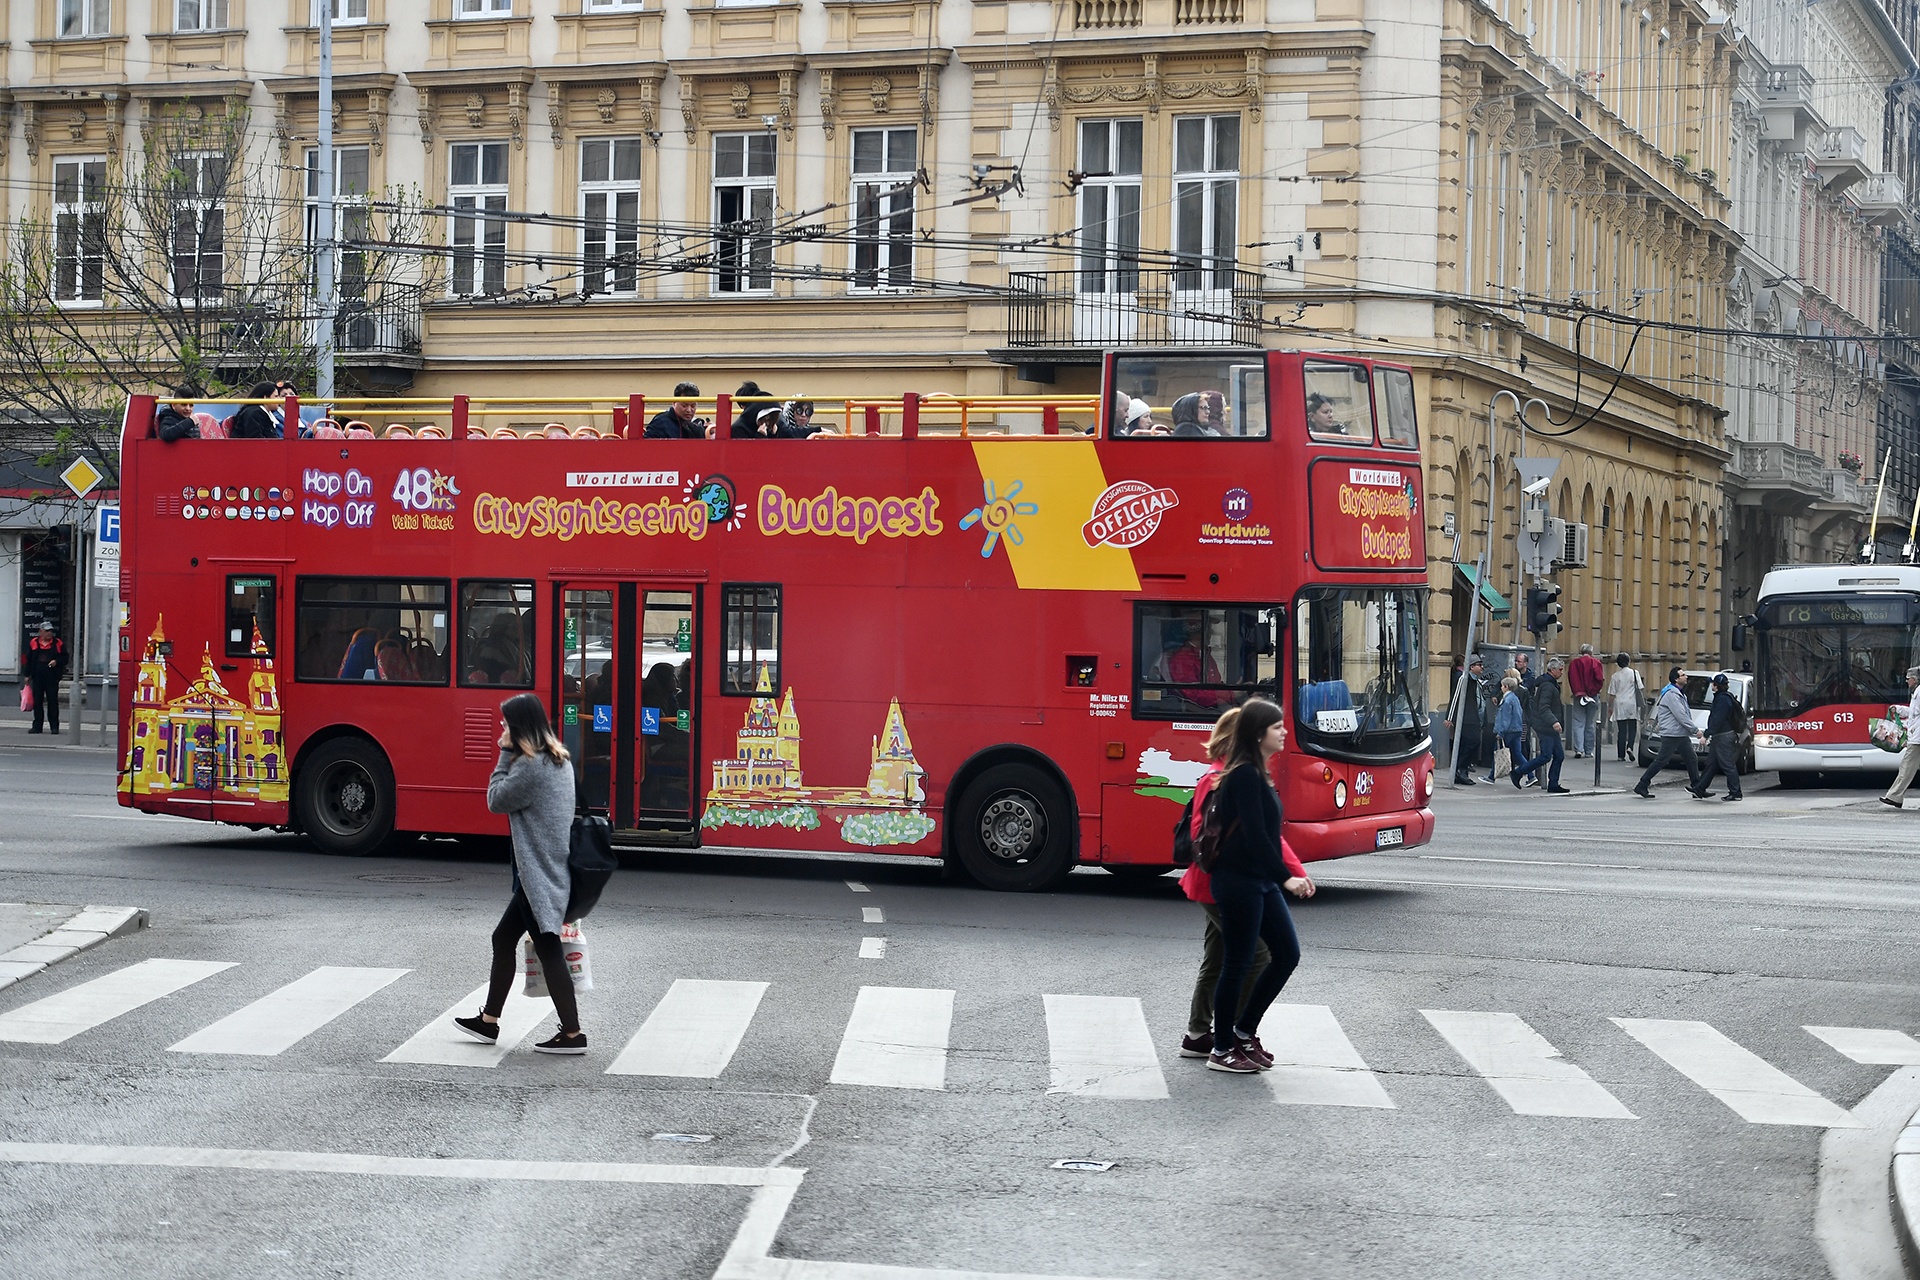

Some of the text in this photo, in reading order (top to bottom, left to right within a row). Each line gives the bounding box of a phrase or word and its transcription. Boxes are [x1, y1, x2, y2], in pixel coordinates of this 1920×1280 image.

[303, 469, 373, 498] Hop On
[575, 473, 675, 485] Worldwide
[1354, 470, 1400, 485] Worldwide
[392, 468, 433, 510] 48
[1098, 484, 1147, 512] CITYSIGHTSEEING
[303, 500, 376, 528] Hop Off
[392, 514, 455, 531] Valid Ticket
[474, 484, 944, 545] CitySightseeing Budapest
[1091, 492, 1174, 540] OFFICIAL
[1120, 518, 1157, 543] TOUR
[1201, 523, 1271, 538] Worldwide
[101, 546, 119, 556] ZÓN
[1224, 538, 1257, 546] Sightseeing
[1361, 522, 1412, 565] Budapest
[1089, 694, 1101, 702] Mr.
[1101, 694, 1118, 702] Nilsz
[1325, 717, 1352, 731] BASILICA
[1833, 713, 1854, 723] 613
[1354, 771, 1367, 795] 48
